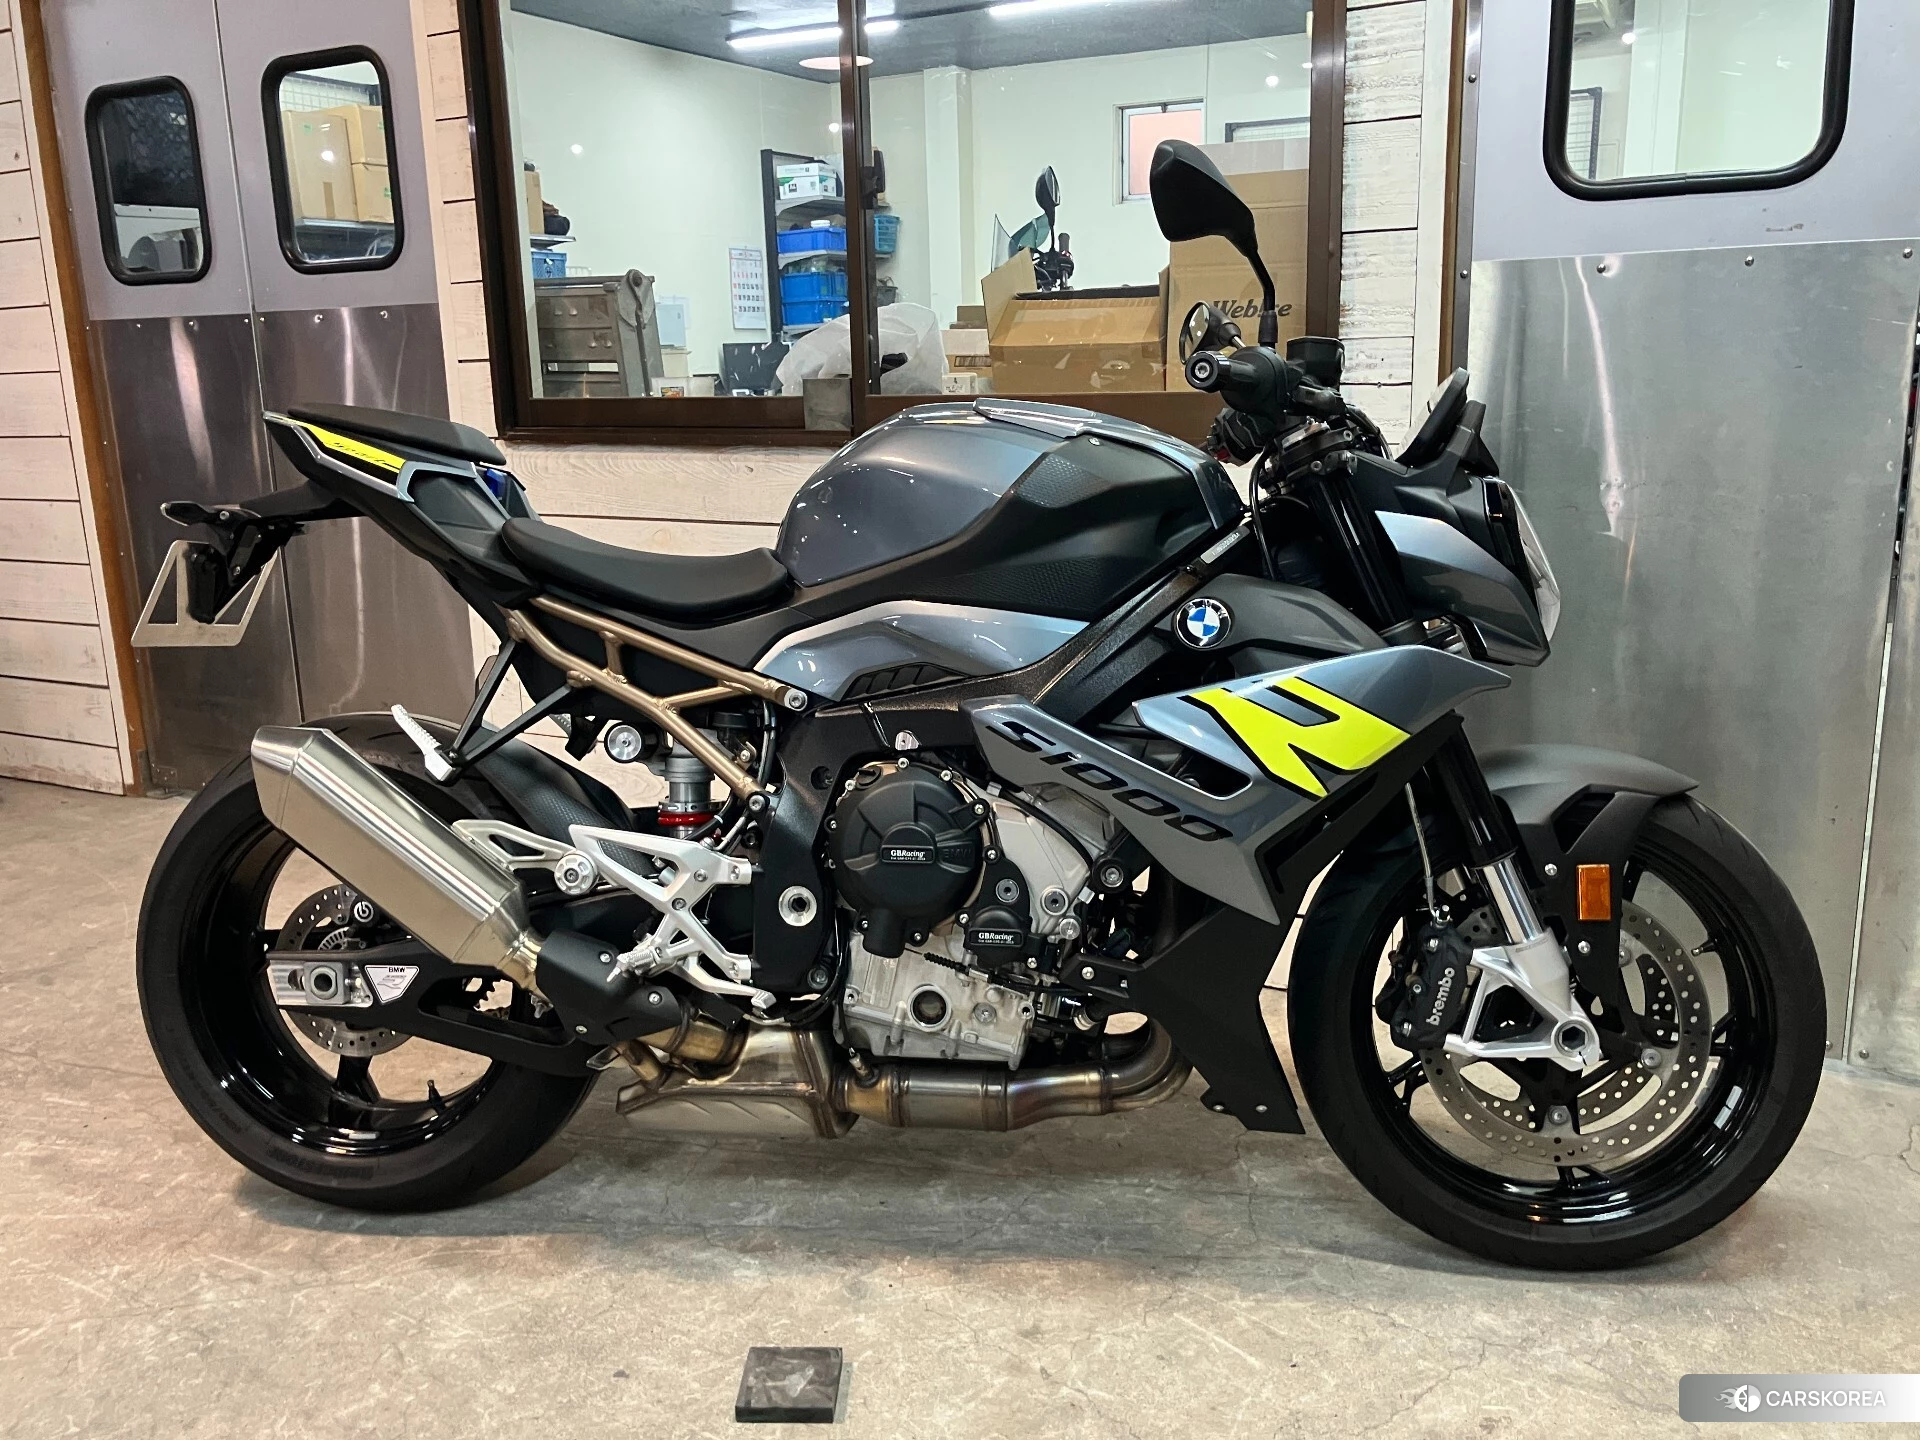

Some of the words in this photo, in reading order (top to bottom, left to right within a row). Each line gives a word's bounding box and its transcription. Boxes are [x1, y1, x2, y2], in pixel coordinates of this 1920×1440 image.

[1213, 299, 1292, 318] Webe
[985, 721, 1234, 842] S1000
[1425, 967, 1456, 1026] brembo
